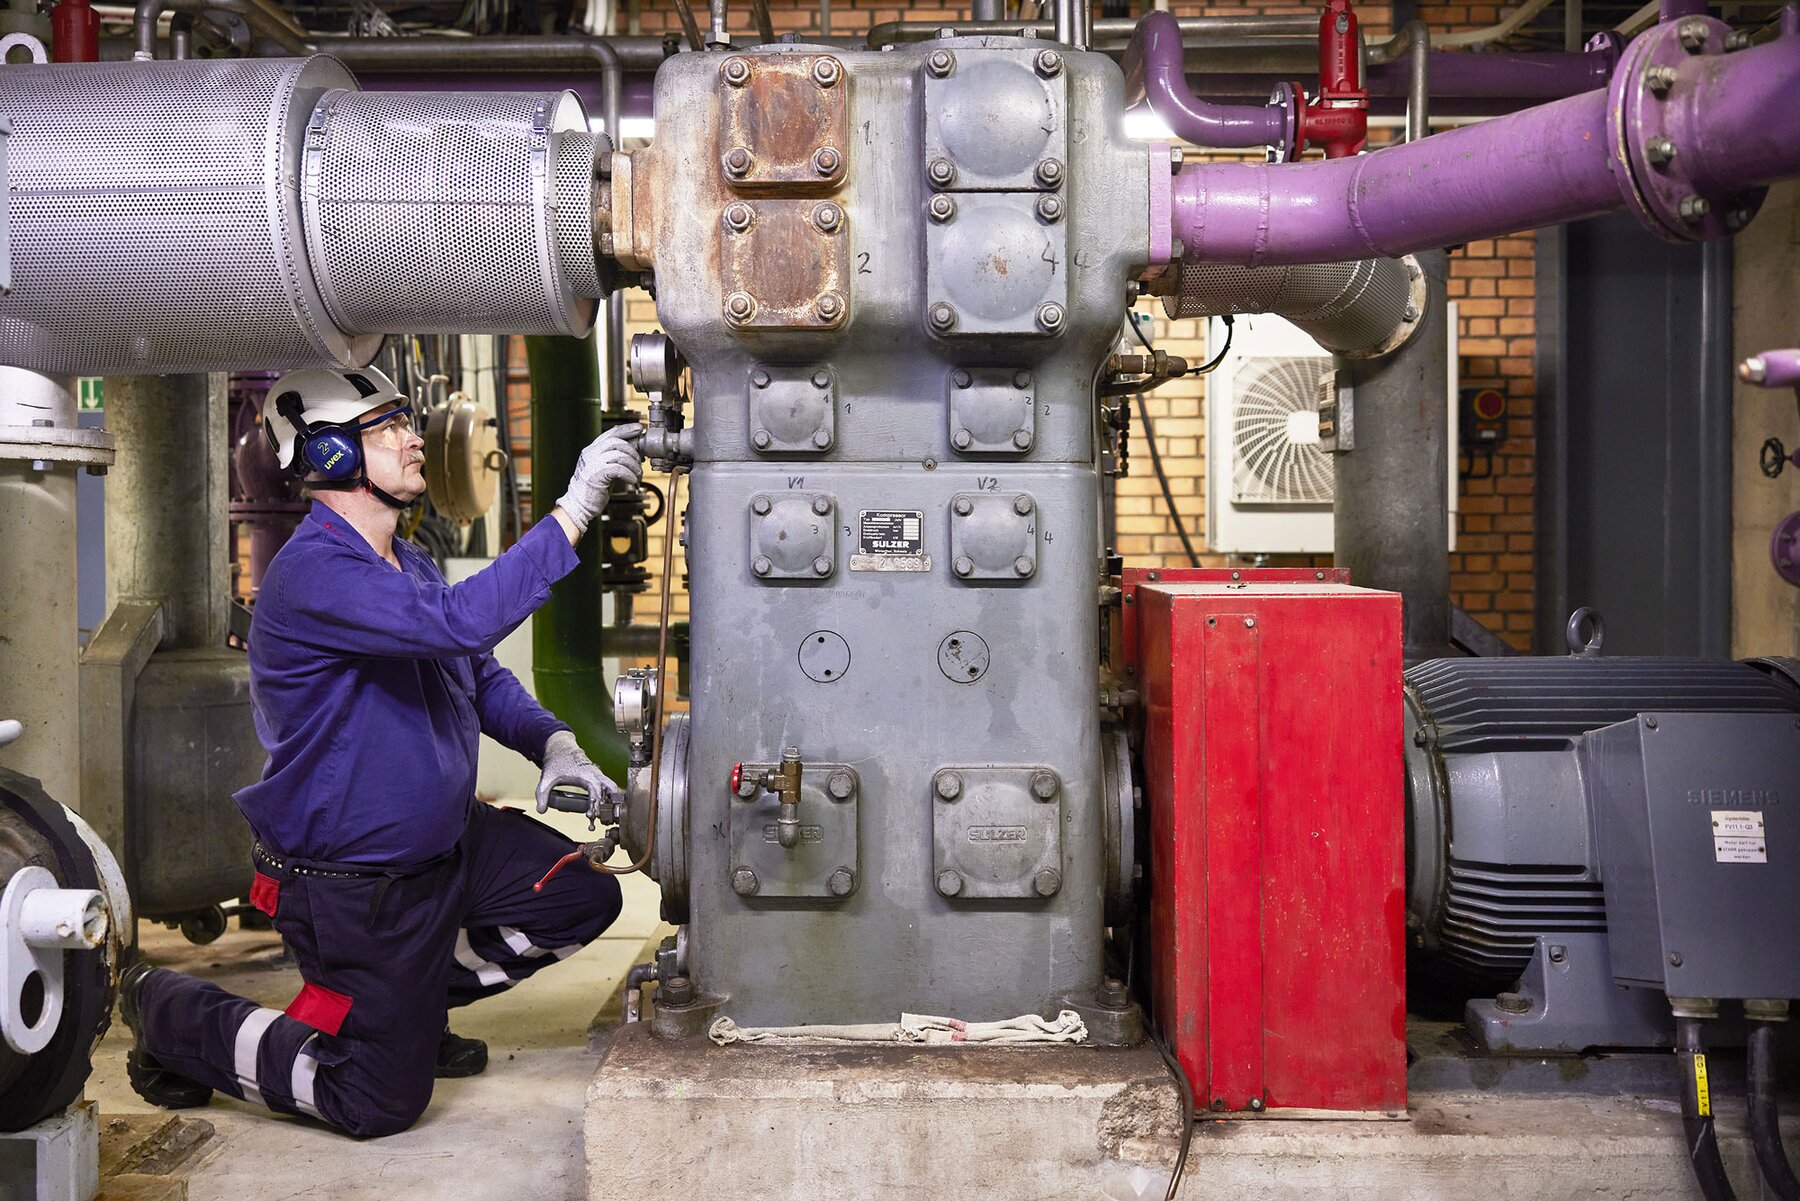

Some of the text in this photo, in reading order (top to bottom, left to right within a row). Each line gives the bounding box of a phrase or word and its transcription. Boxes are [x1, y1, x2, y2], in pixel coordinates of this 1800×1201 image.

[857, 252, 872, 275] 2
[1041, 241, 1060, 275] 4
[823, 394, 829, 404] 1
[1025, 396, 1032, 405] 2
[844, 403, 851, 414] 1
[1044, 405, 1050, 416] 2
[317, 441, 331, 456] 2
[324, 450, 344, 470] uvex
[788, 476, 805, 489] V1
[977, 476, 1001, 491] V2
[810, 524, 819, 535] 3
[843, 525, 852, 537] 3
[1027, 524, 1035, 535] 4
[872, 540, 910, 548] SULZER
[1044, 531, 1054, 545] 4
[1687, 789, 1780, 805] SIEMENS
[1066, 810, 1072, 823] 6
[969, 829, 1026, 840] SULZER
